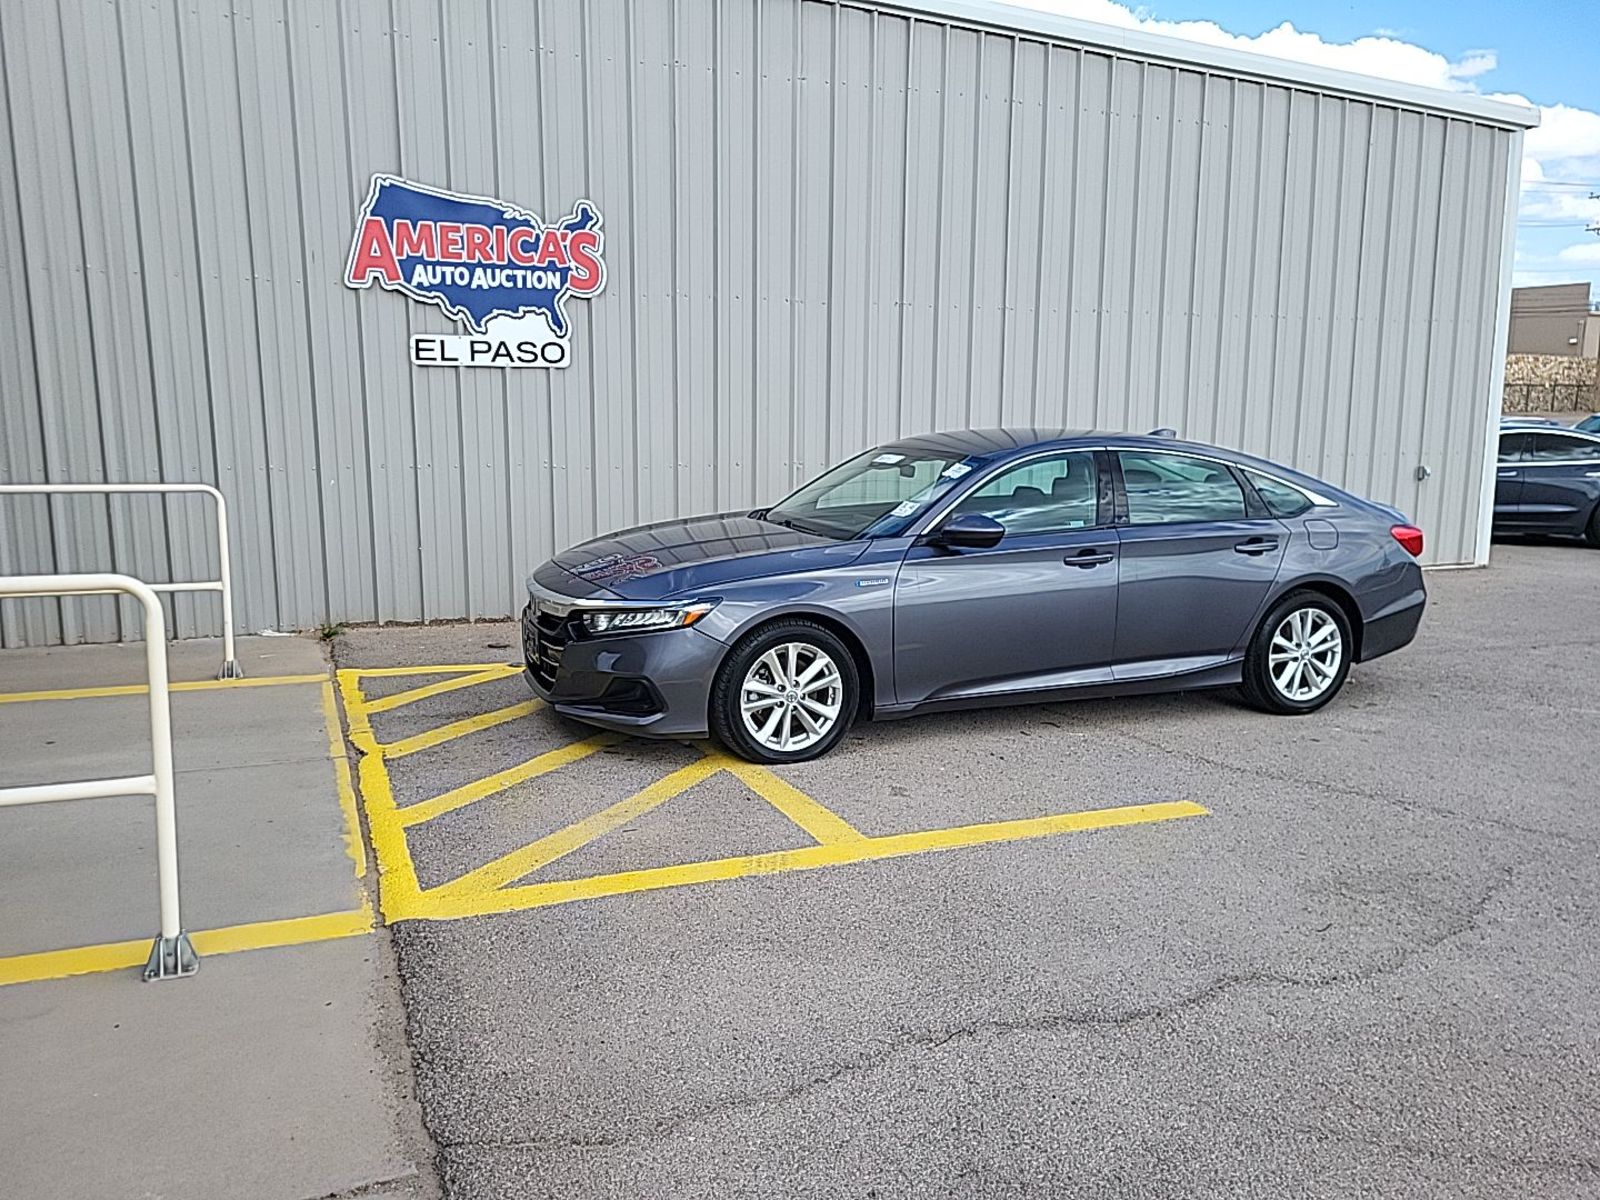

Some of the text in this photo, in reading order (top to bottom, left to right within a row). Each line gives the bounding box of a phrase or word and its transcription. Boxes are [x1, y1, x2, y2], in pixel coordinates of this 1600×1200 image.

[351, 218, 600, 291] AMERICA'S
[411, 264, 561, 290] AUTO AUCTION
[414, 338, 565, 364] EL PASO
